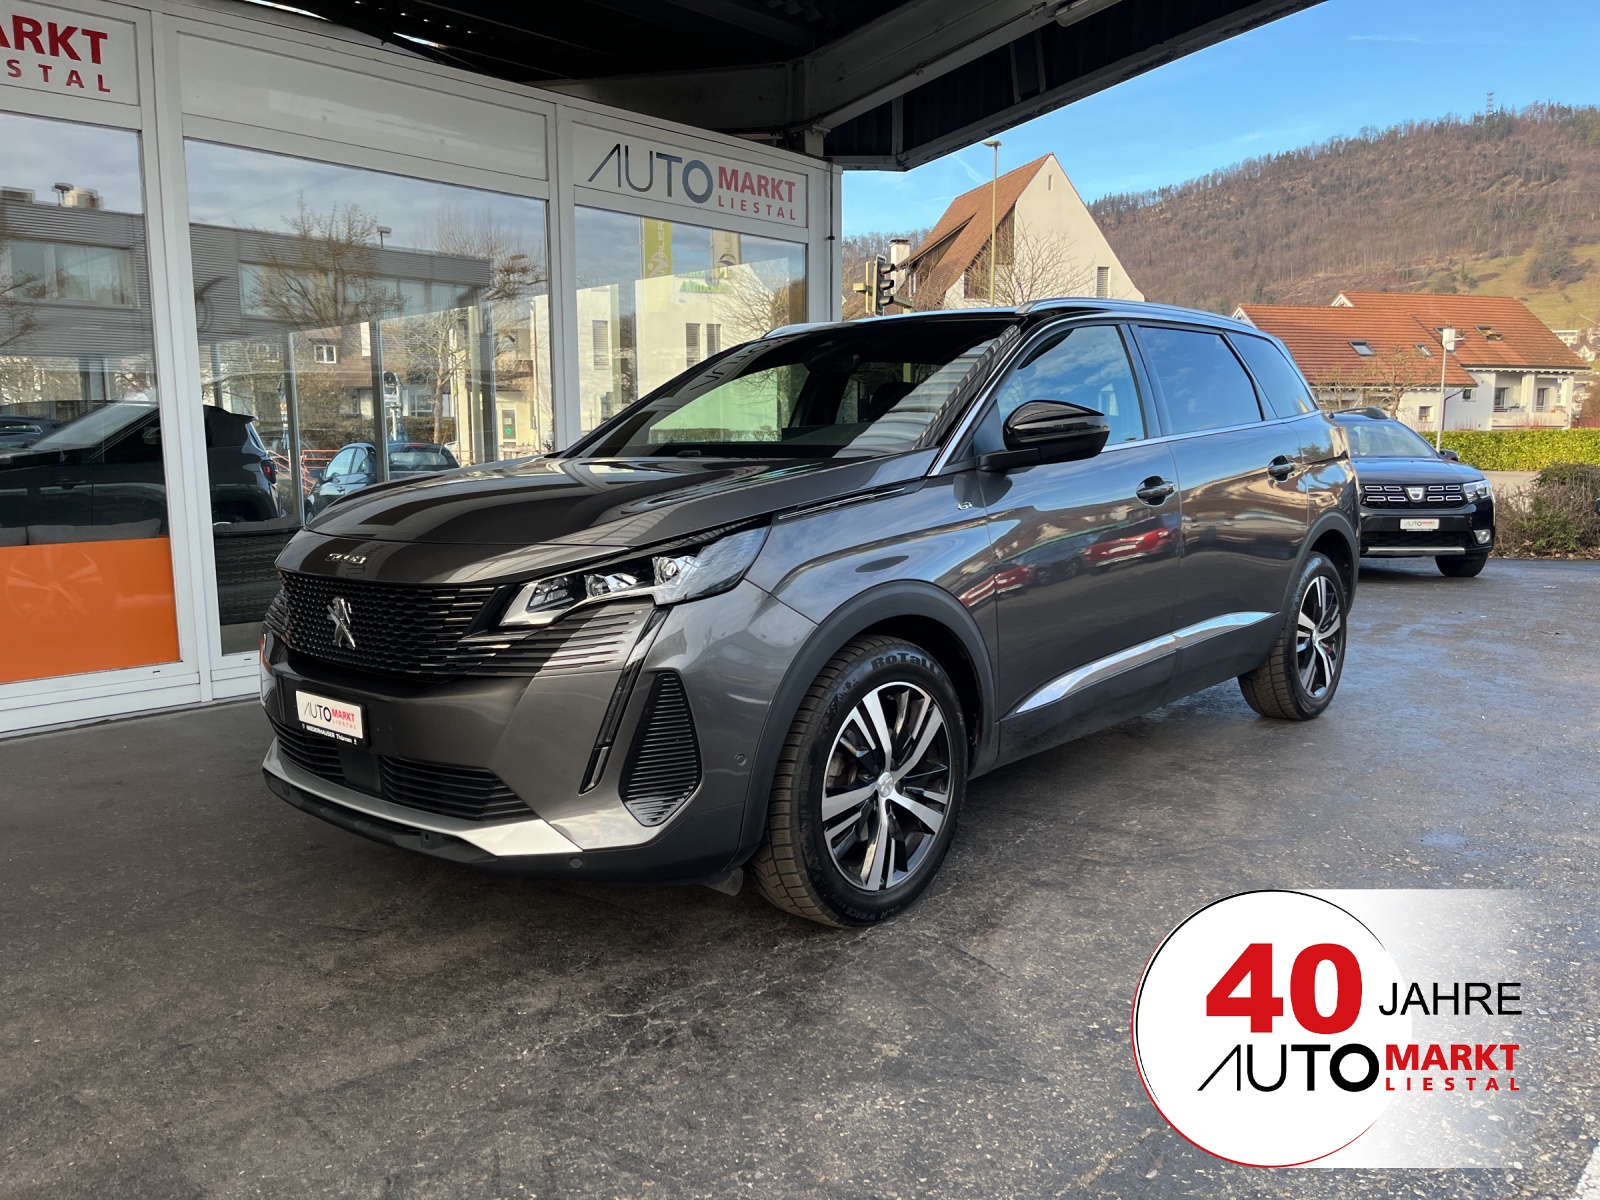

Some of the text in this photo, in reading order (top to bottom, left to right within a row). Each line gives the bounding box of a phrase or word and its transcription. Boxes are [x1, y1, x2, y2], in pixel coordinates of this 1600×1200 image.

[587, 143, 795, 204] AUTO MARKT
[718, 195, 795, 220] LIESTAL
[304, 702, 355, 722] AUTO MARKT
[332, 719, 357, 730] LIESTAL
